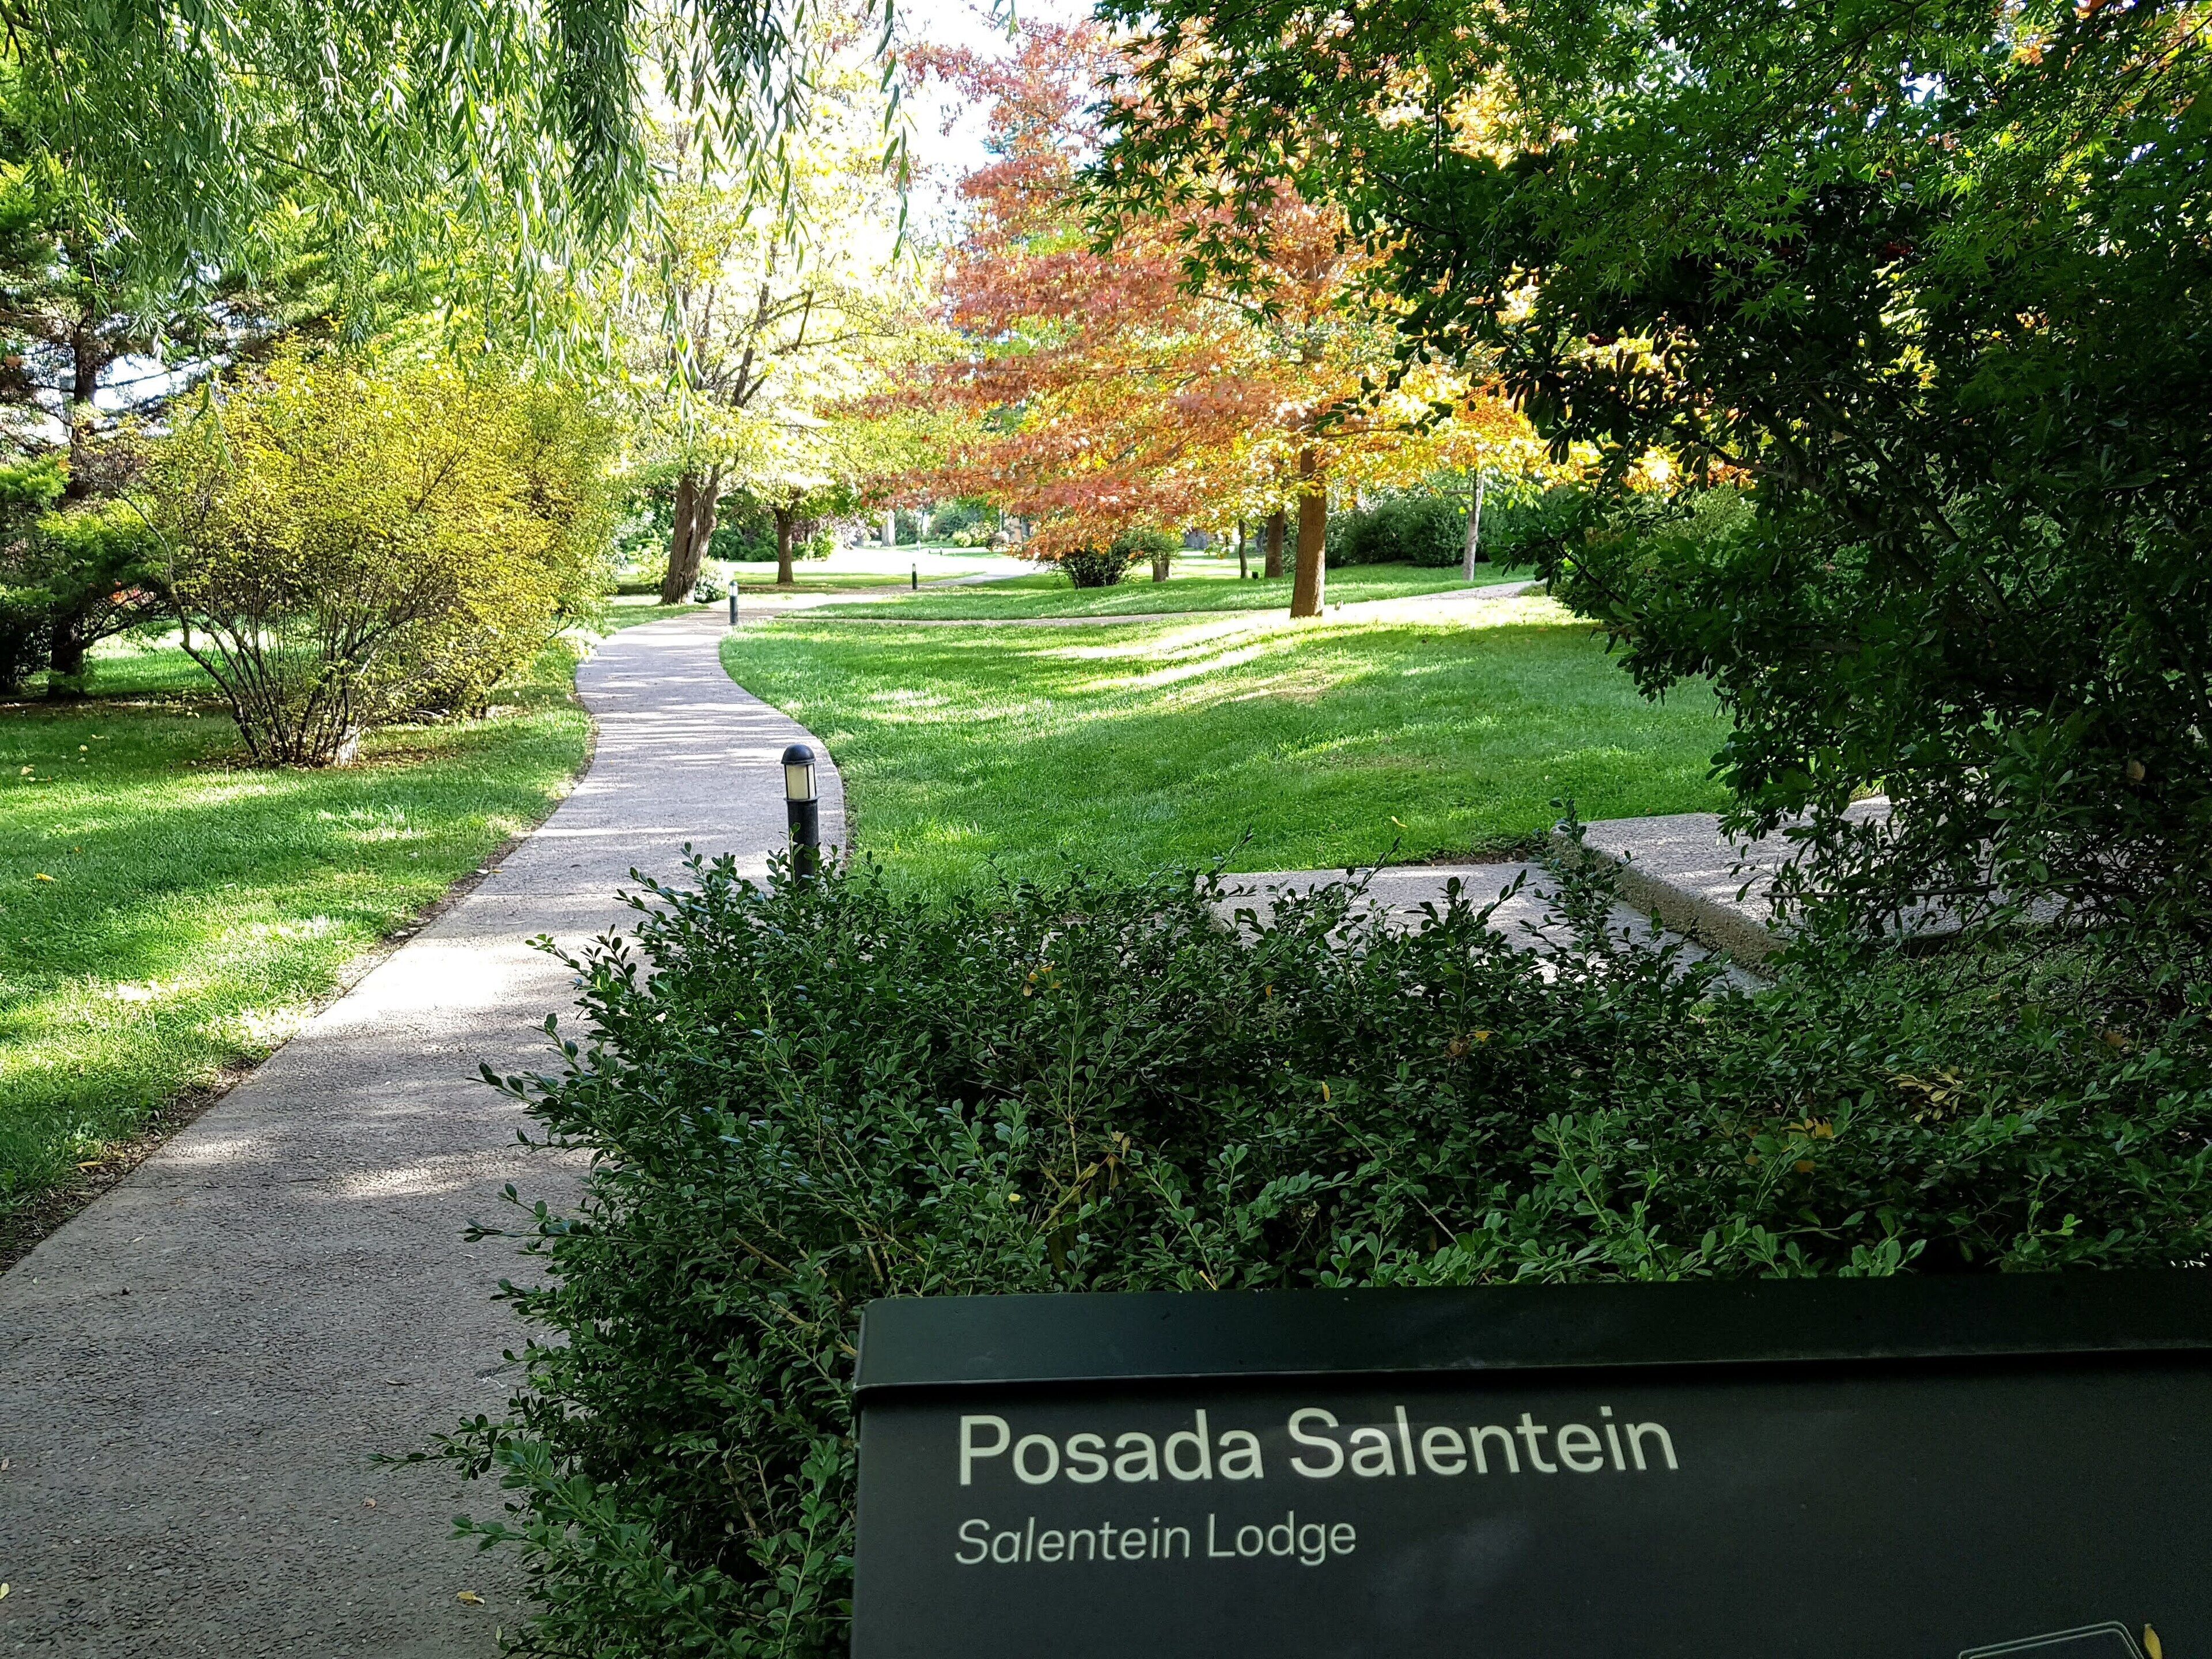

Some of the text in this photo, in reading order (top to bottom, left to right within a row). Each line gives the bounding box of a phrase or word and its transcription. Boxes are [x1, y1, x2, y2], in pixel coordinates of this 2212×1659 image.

[959, 1406, 1679, 1486] Posada Salentein
[955, 1510, 1357, 1566] Salentein Lodge
